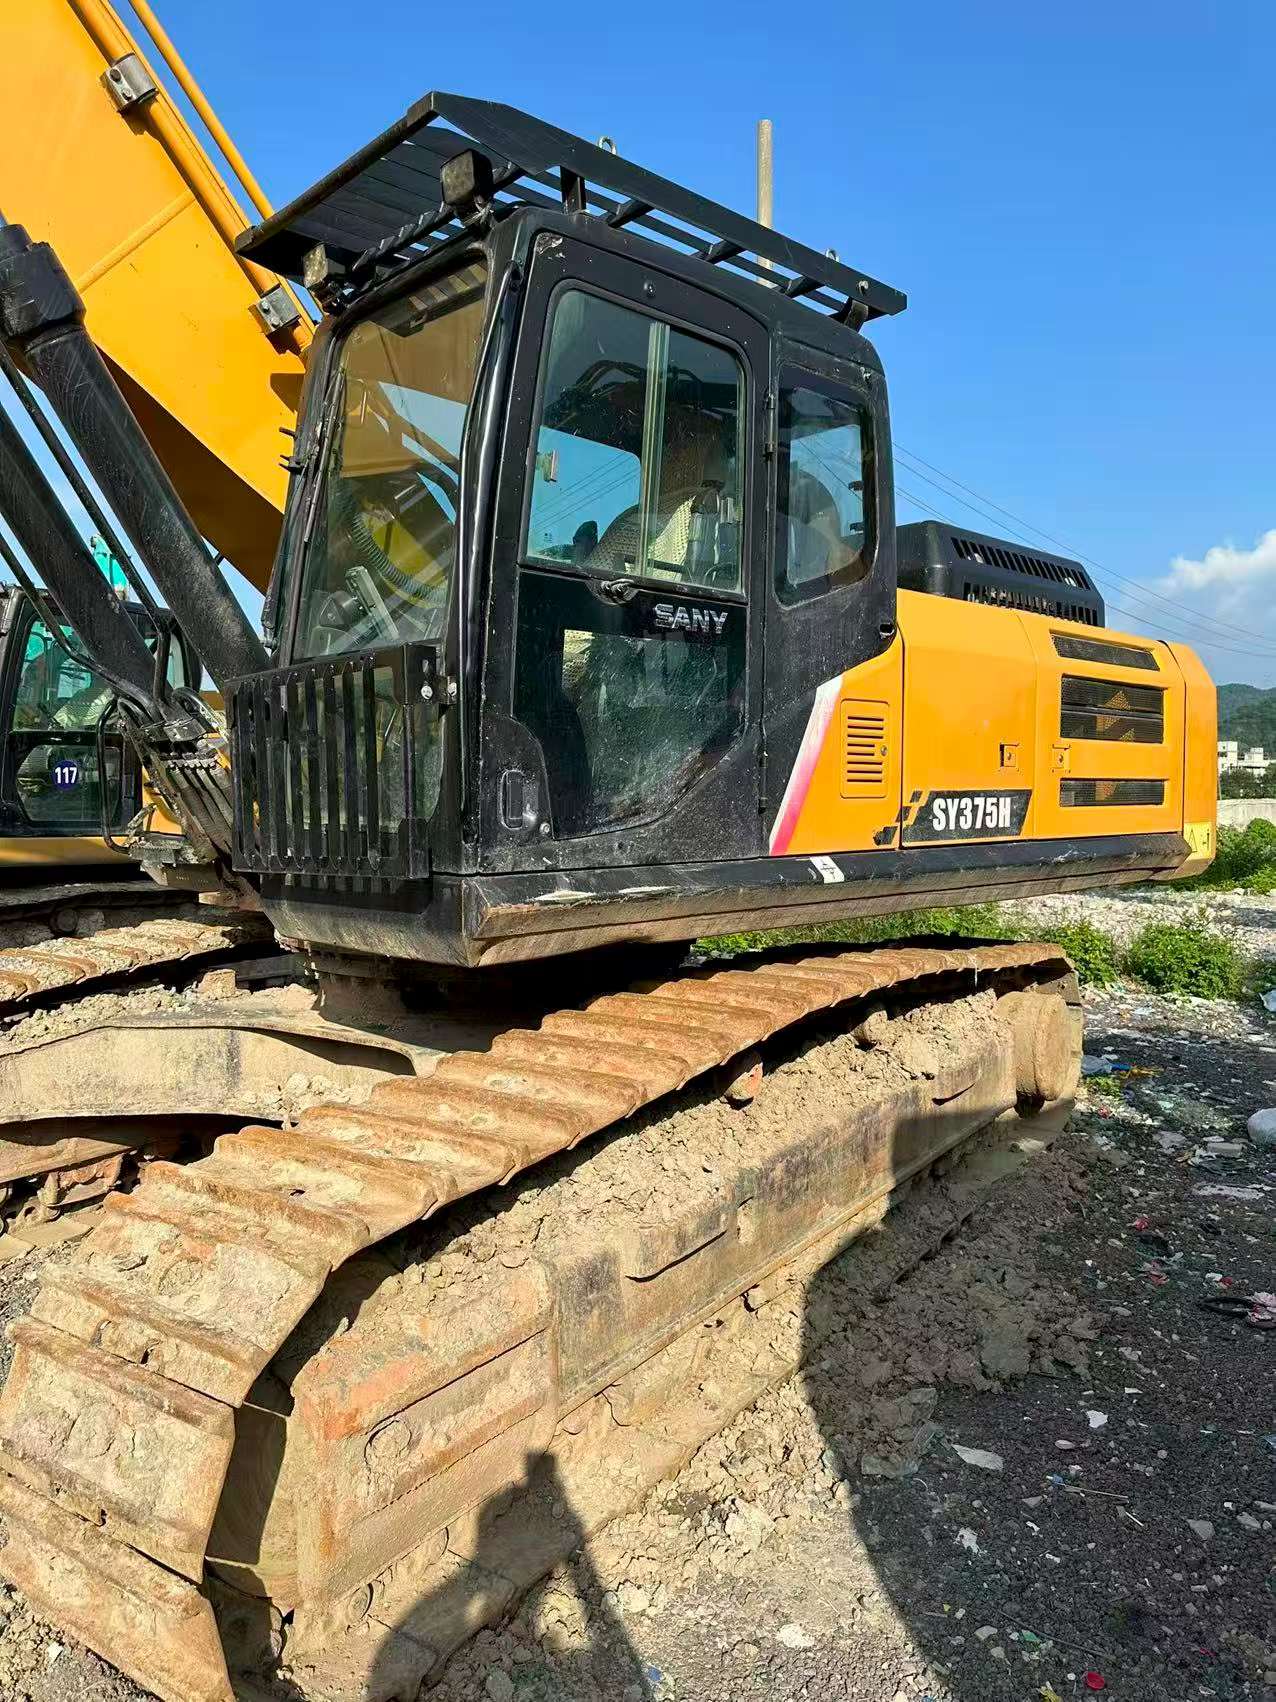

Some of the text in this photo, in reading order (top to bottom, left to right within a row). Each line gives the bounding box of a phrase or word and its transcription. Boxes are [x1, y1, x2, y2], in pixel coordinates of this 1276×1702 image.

[654, 603, 729, 634] SANY
[54, 766, 78, 784] 117
[932, 797, 1012, 831] SY375H
